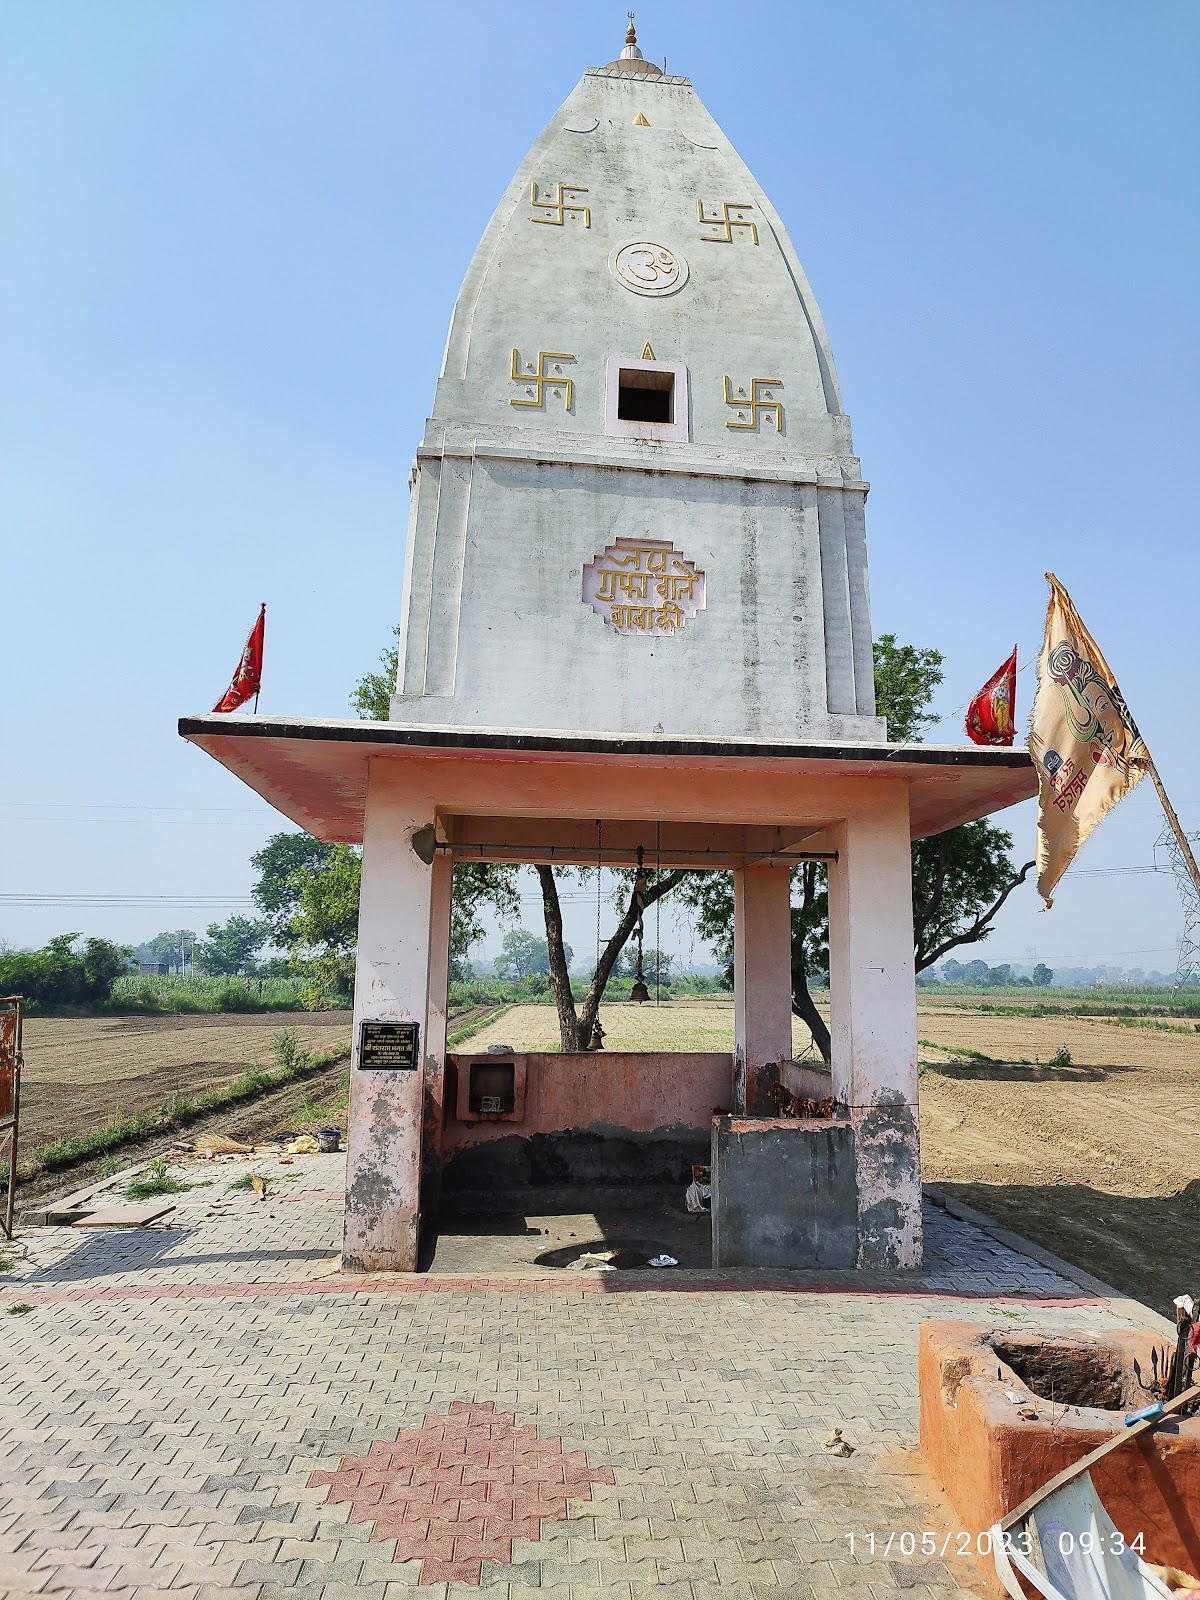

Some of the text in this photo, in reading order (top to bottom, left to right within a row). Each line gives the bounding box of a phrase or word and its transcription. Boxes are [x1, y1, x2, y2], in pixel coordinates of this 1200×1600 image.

[608, 547, 674, 572] जय
[595, 570, 654, 602] गुफा
[610, 600, 685, 632] बाबा की
